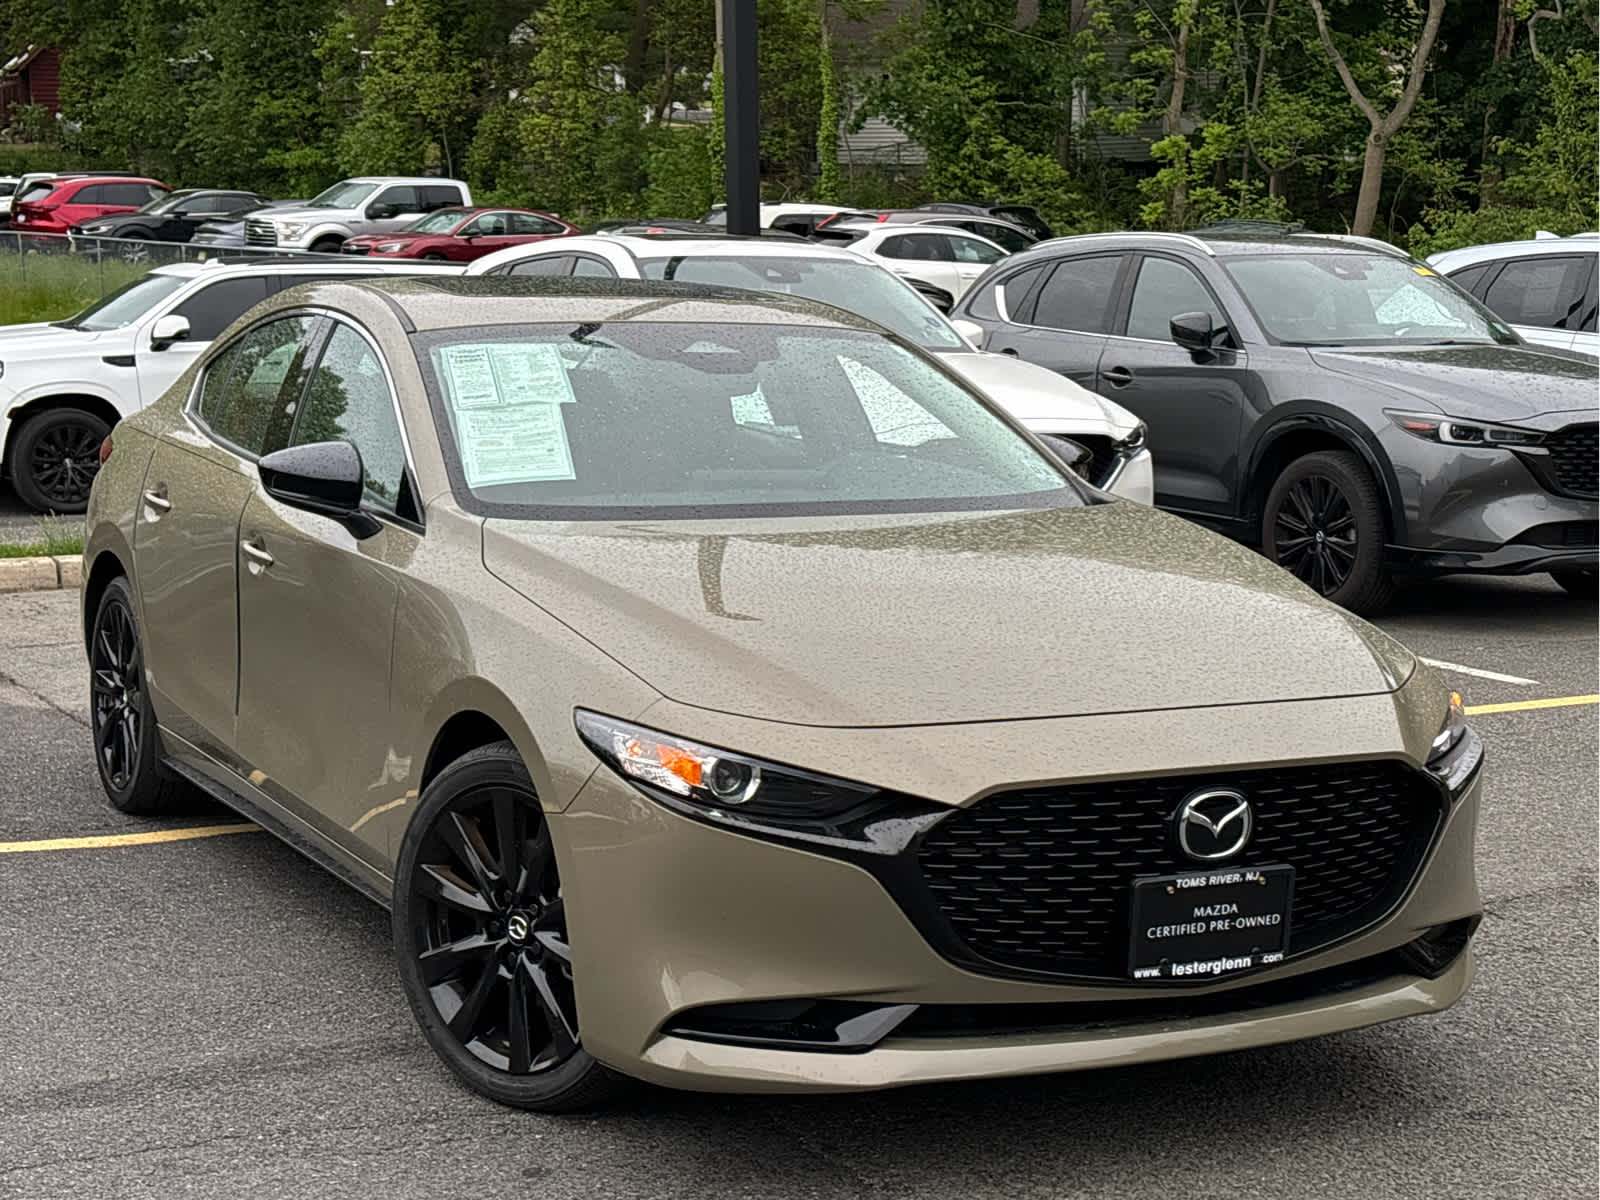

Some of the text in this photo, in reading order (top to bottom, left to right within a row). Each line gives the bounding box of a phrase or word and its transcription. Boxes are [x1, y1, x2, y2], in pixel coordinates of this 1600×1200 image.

[1176, 876, 1207, 889] TOMS
[1193, 903, 1239, 918] MAZDA
[1147, 913, 1281, 939] CERTIFIED PRE-OWNED
[1172, 956, 1252, 976] lesterglenn
